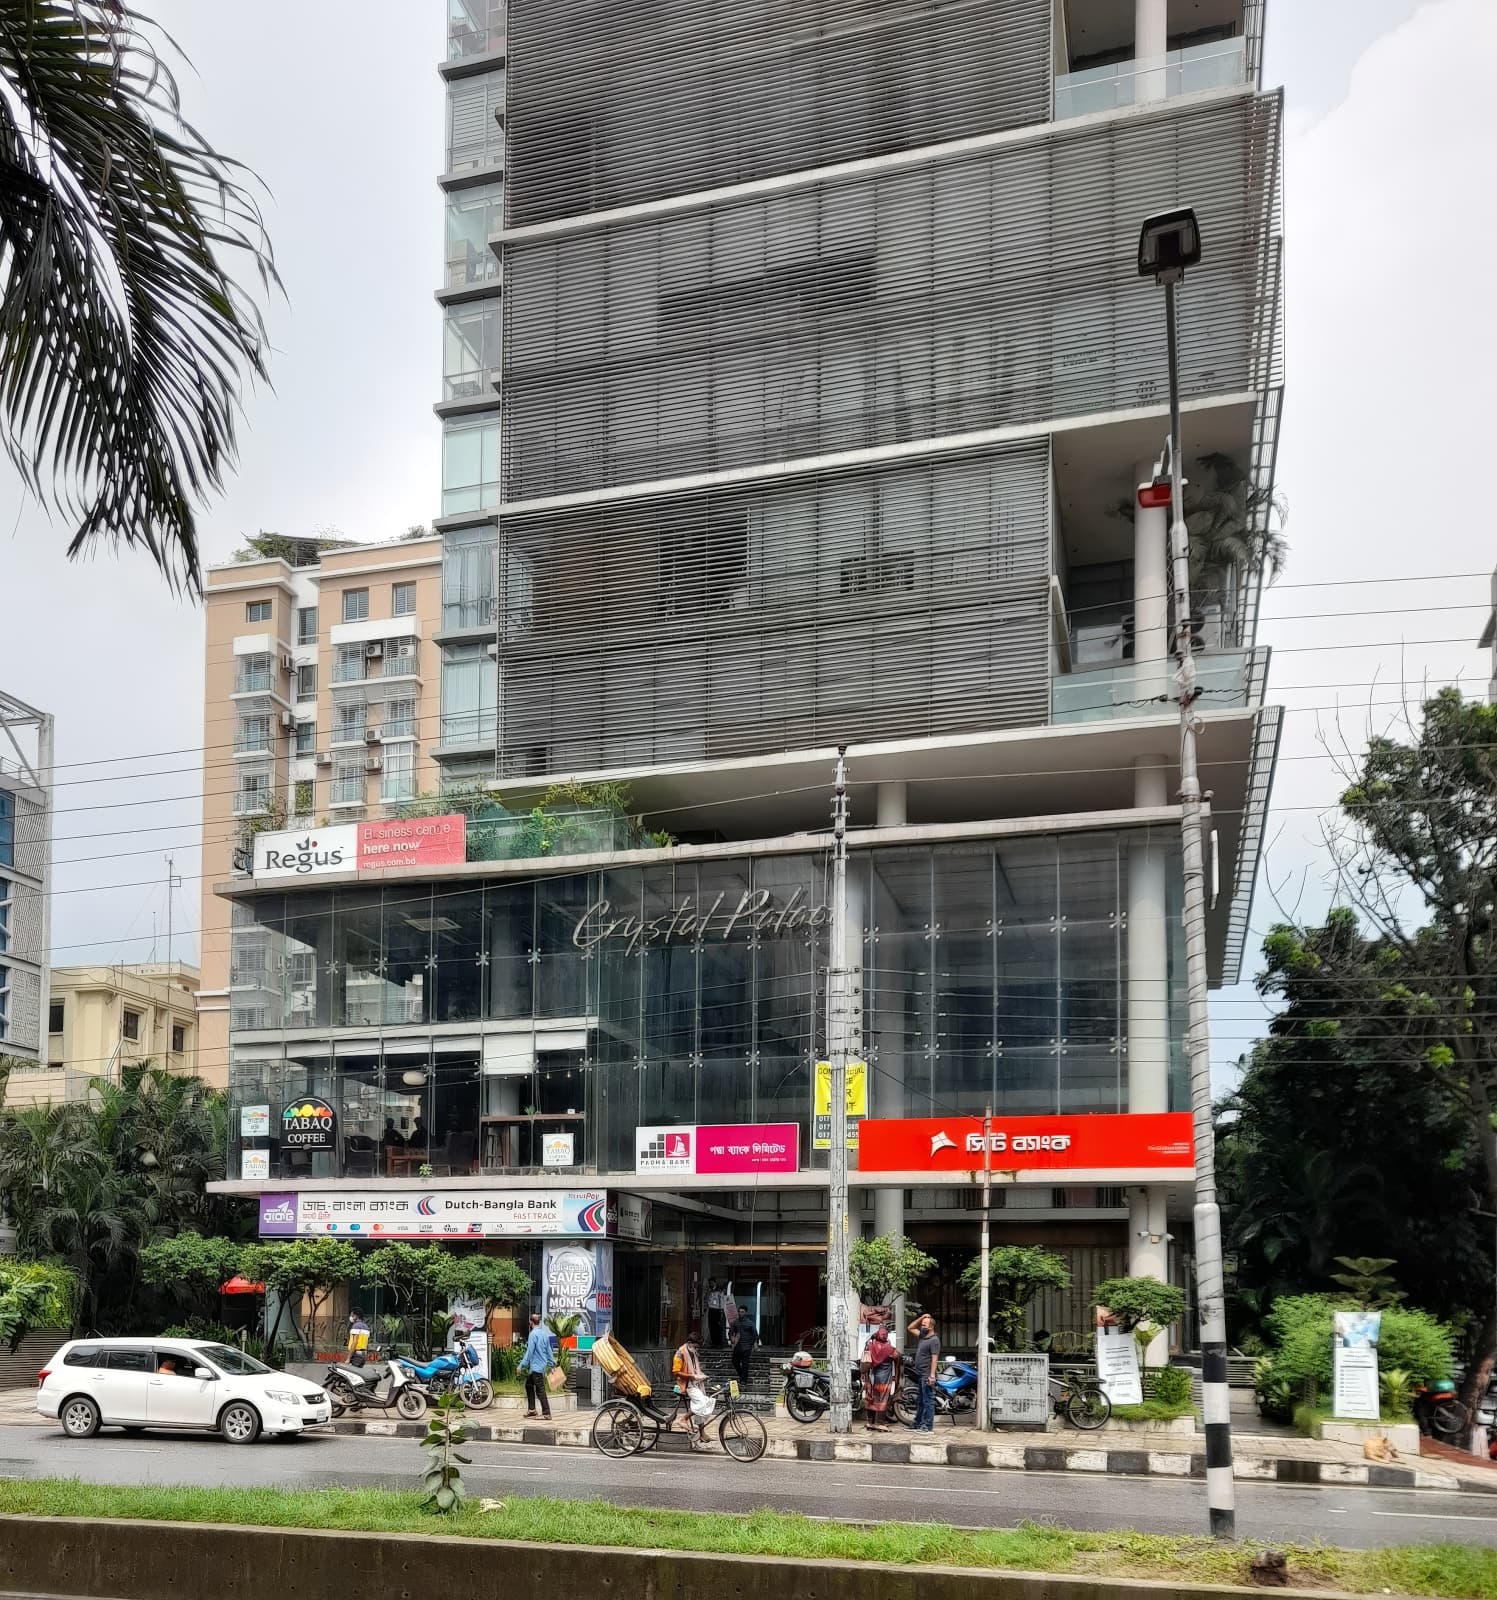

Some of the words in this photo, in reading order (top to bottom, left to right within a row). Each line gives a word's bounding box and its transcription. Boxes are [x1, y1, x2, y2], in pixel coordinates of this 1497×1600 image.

[364, 826, 413, 840] Bsiness
[363, 842, 390, 854] here
[393, 840, 420, 852] now
[266, 848, 343, 873] Regus
[363, 857, 416, 869] regus.com.bd
[572, 891, 726, 958] Crystal
[282, 1116, 333, 1132] TABAQ
[287, 1133, 326, 1143] COFFEE
[445, 1200, 524, 1211] Dutch-Bangla
[527, 1199, 557, 1210] Bank
[513, 1212, 530, 1220] FAST
[532, 1212, 557, 1220] TRACK
[549, 1272, 589, 1283] SAVES
[549, 1297, 587, 1308] MONEY
